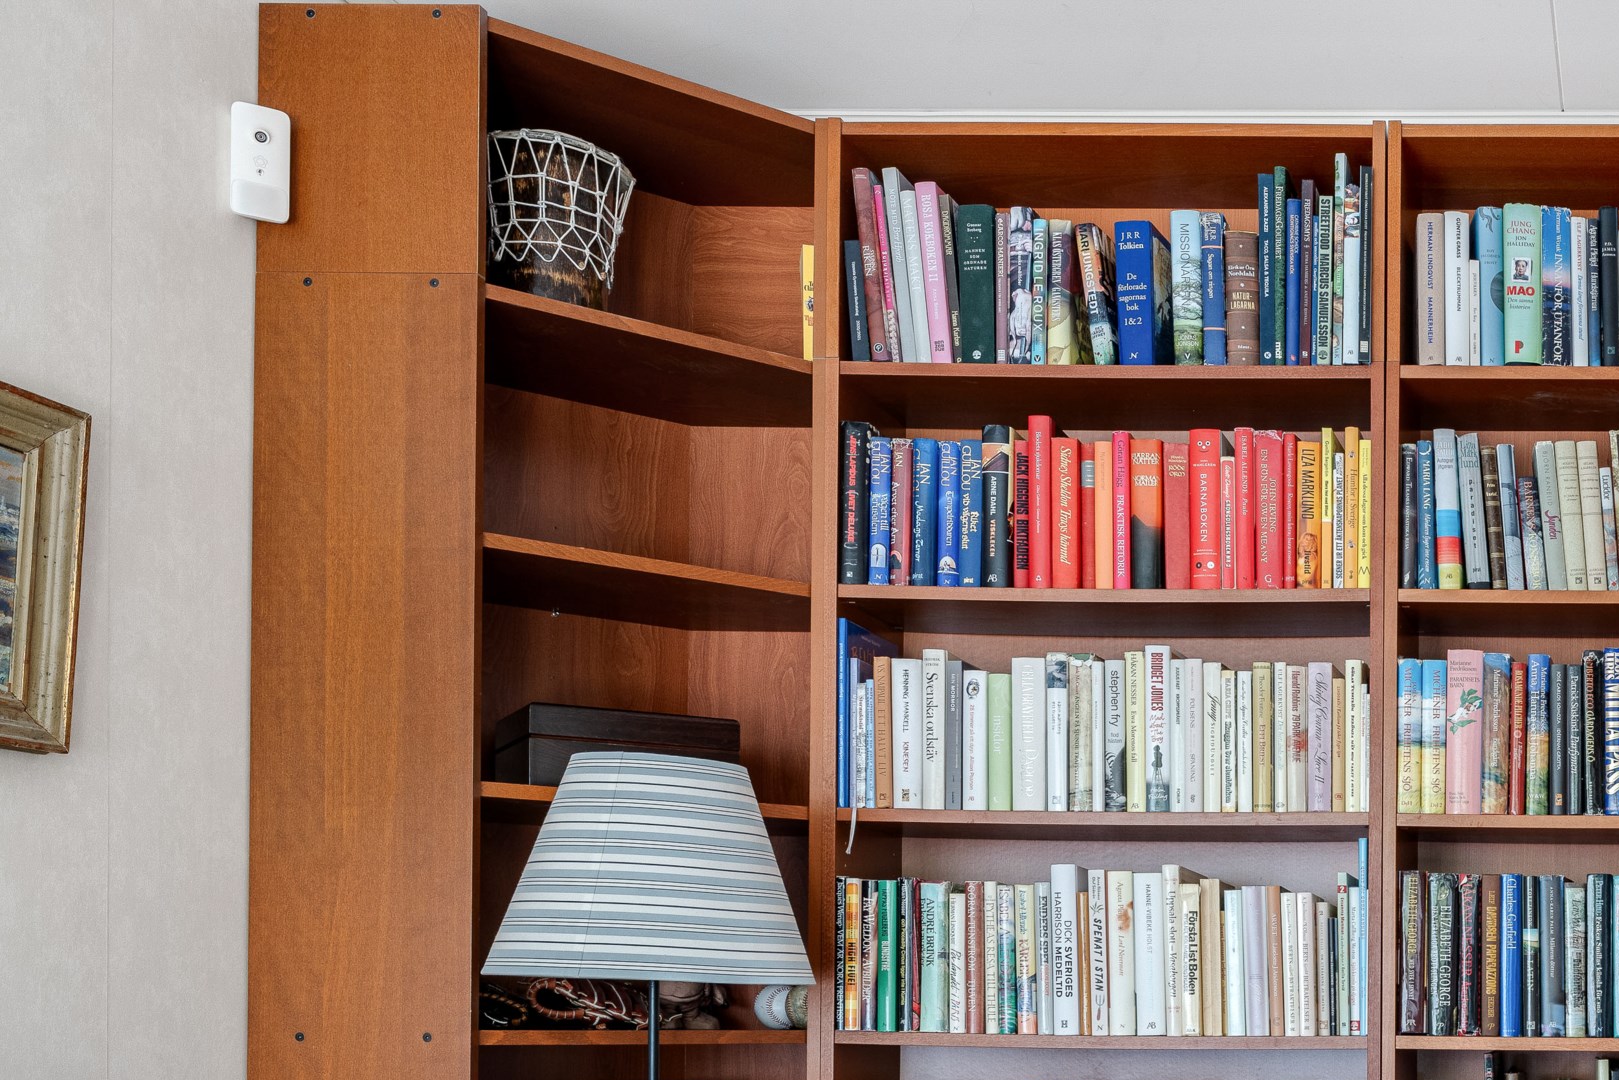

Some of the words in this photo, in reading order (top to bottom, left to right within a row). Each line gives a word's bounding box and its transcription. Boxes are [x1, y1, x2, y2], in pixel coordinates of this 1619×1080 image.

[920, 194, 933, 219] ROSA
[1077, 224, 1090, 252] MARI
[1120, 232, 1125, 242] J
[1319, 198, 1331, 250] STREETFOOD
[923, 221, 937, 271] KOKBOKEN
[1033, 227, 1043, 273] INGRID
[928, 273, 938, 282] II
[1033, 276, 1044, 292] LE
[1082, 251, 1099, 315] JUNGSTEDT
[1117, 283, 1148, 292] förlorade
[1126, 273, 1137, 281] De
[1319, 253, 1330, 290] MARCUS
[1125, 303, 1140, 311] bok
[1506, 286, 1535, 296] MAO
[1033, 296, 1043, 331] ROUX
[1124, 318, 1143, 326] 1&2
[1318, 291, 1330, 347] SAMUELSSON
[961, 445, 972, 490] GUILLOU
[971, 459, 981, 479] JAN
[1016, 452, 1029, 476] JACK
[1059, 446, 1071, 475] Sidney
[1301, 449, 1316, 467] LIZA
[1422, 459, 1431, 485] MARIA
[989, 496, 997, 515] DAHL
[1016, 478, 1029, 515] HIGGINS
[1060, 474, 1071, 507] Sheldon
[1302, 470, 1315, 520] MARKLUND
[1423, 487, 1431, 509] LANG
[1059, 509, 1071, 533] Tracys
[1116, 494, 1125, 537] PRAKTISK
[1200, 473, 1208, 542] BARNABOKEN
[1544, 510, 1561, 540] Synden
[1016, 519, 1029, 570] BIKTFADERN
[1060, 533, 1071, 565] hämnd
[1117, 540, 1125, 577] RETORIK
[1304, 550, 1312, 575] livstid
[1130, 653, 1139, 678] HÅKAN
[1151, 652, 1164, 684] BRIDGET
[1291, 670, 1300, 689] Harold
[1604, 652, 1615, 680] URIS
[925, 672, 938, 719] Svenska
[1108, 670, 1121, 711] stephen
[1151, 685, 1164, 711] JONES
[1291, 689, 1300, 712] Robbins
[1108, 714, 1121, 727] fry
[925, 721, 938, 763] ordstäv
[1505, 878, 1517, 912] Charles
[925, 898, 937, 935] ANDRÉ
[1054, 891, 1063, 944] HARRISON
[1064, 920, 1072, 944] DICK
[1188, 910, 1198, 943] Första
[1506, 913, 1517, 949] Garfield
[926, 935, 935, 967] BRINK
[1093, 918, 1103, 956] SPENAT
[1439, 905, 1452, 965] ELIZABETH
[847, 942, 856, 962] HIGH
[1188, 943, 1198, 962] List
[1055, 946, 1063, 998] MEDELTID
[1064, 946, 1073, 998] SVERIGES
[1094, 966, 1104, 992] STAN
[1189, 963, 1198, 995] Boken
[1440, 965, 1451, 1007] GEORGE
